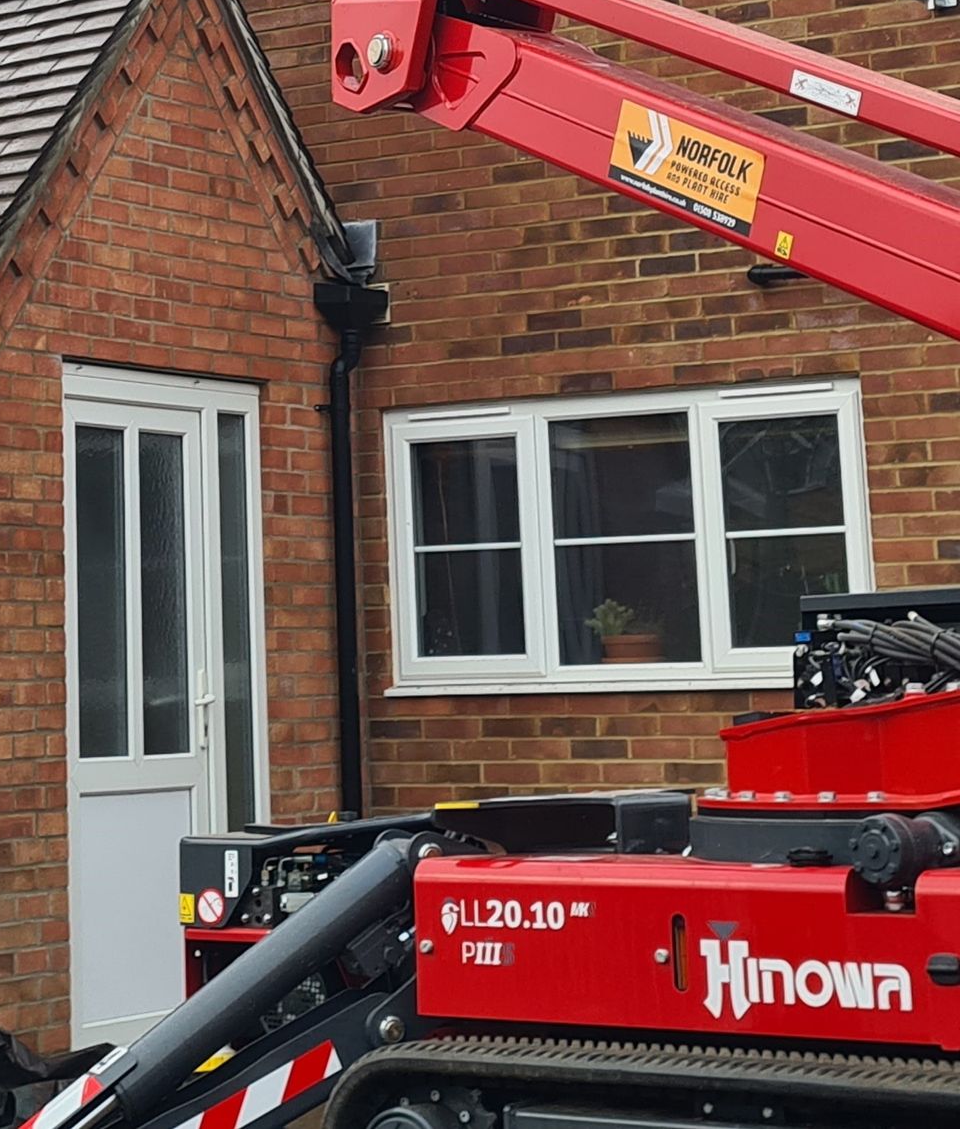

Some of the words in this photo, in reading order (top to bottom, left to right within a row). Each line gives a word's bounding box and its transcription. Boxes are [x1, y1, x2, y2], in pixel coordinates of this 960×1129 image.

[676, 135, 753, 183] NORFOLK
[670, 160, 708, 183] POWERED
[710, 176, 741, 196] ACCESS
[682, 177, 708, 195] PLANT
[709, 189, 730, 204] HIRE
[460, 899, 565, 930] LL20.10
